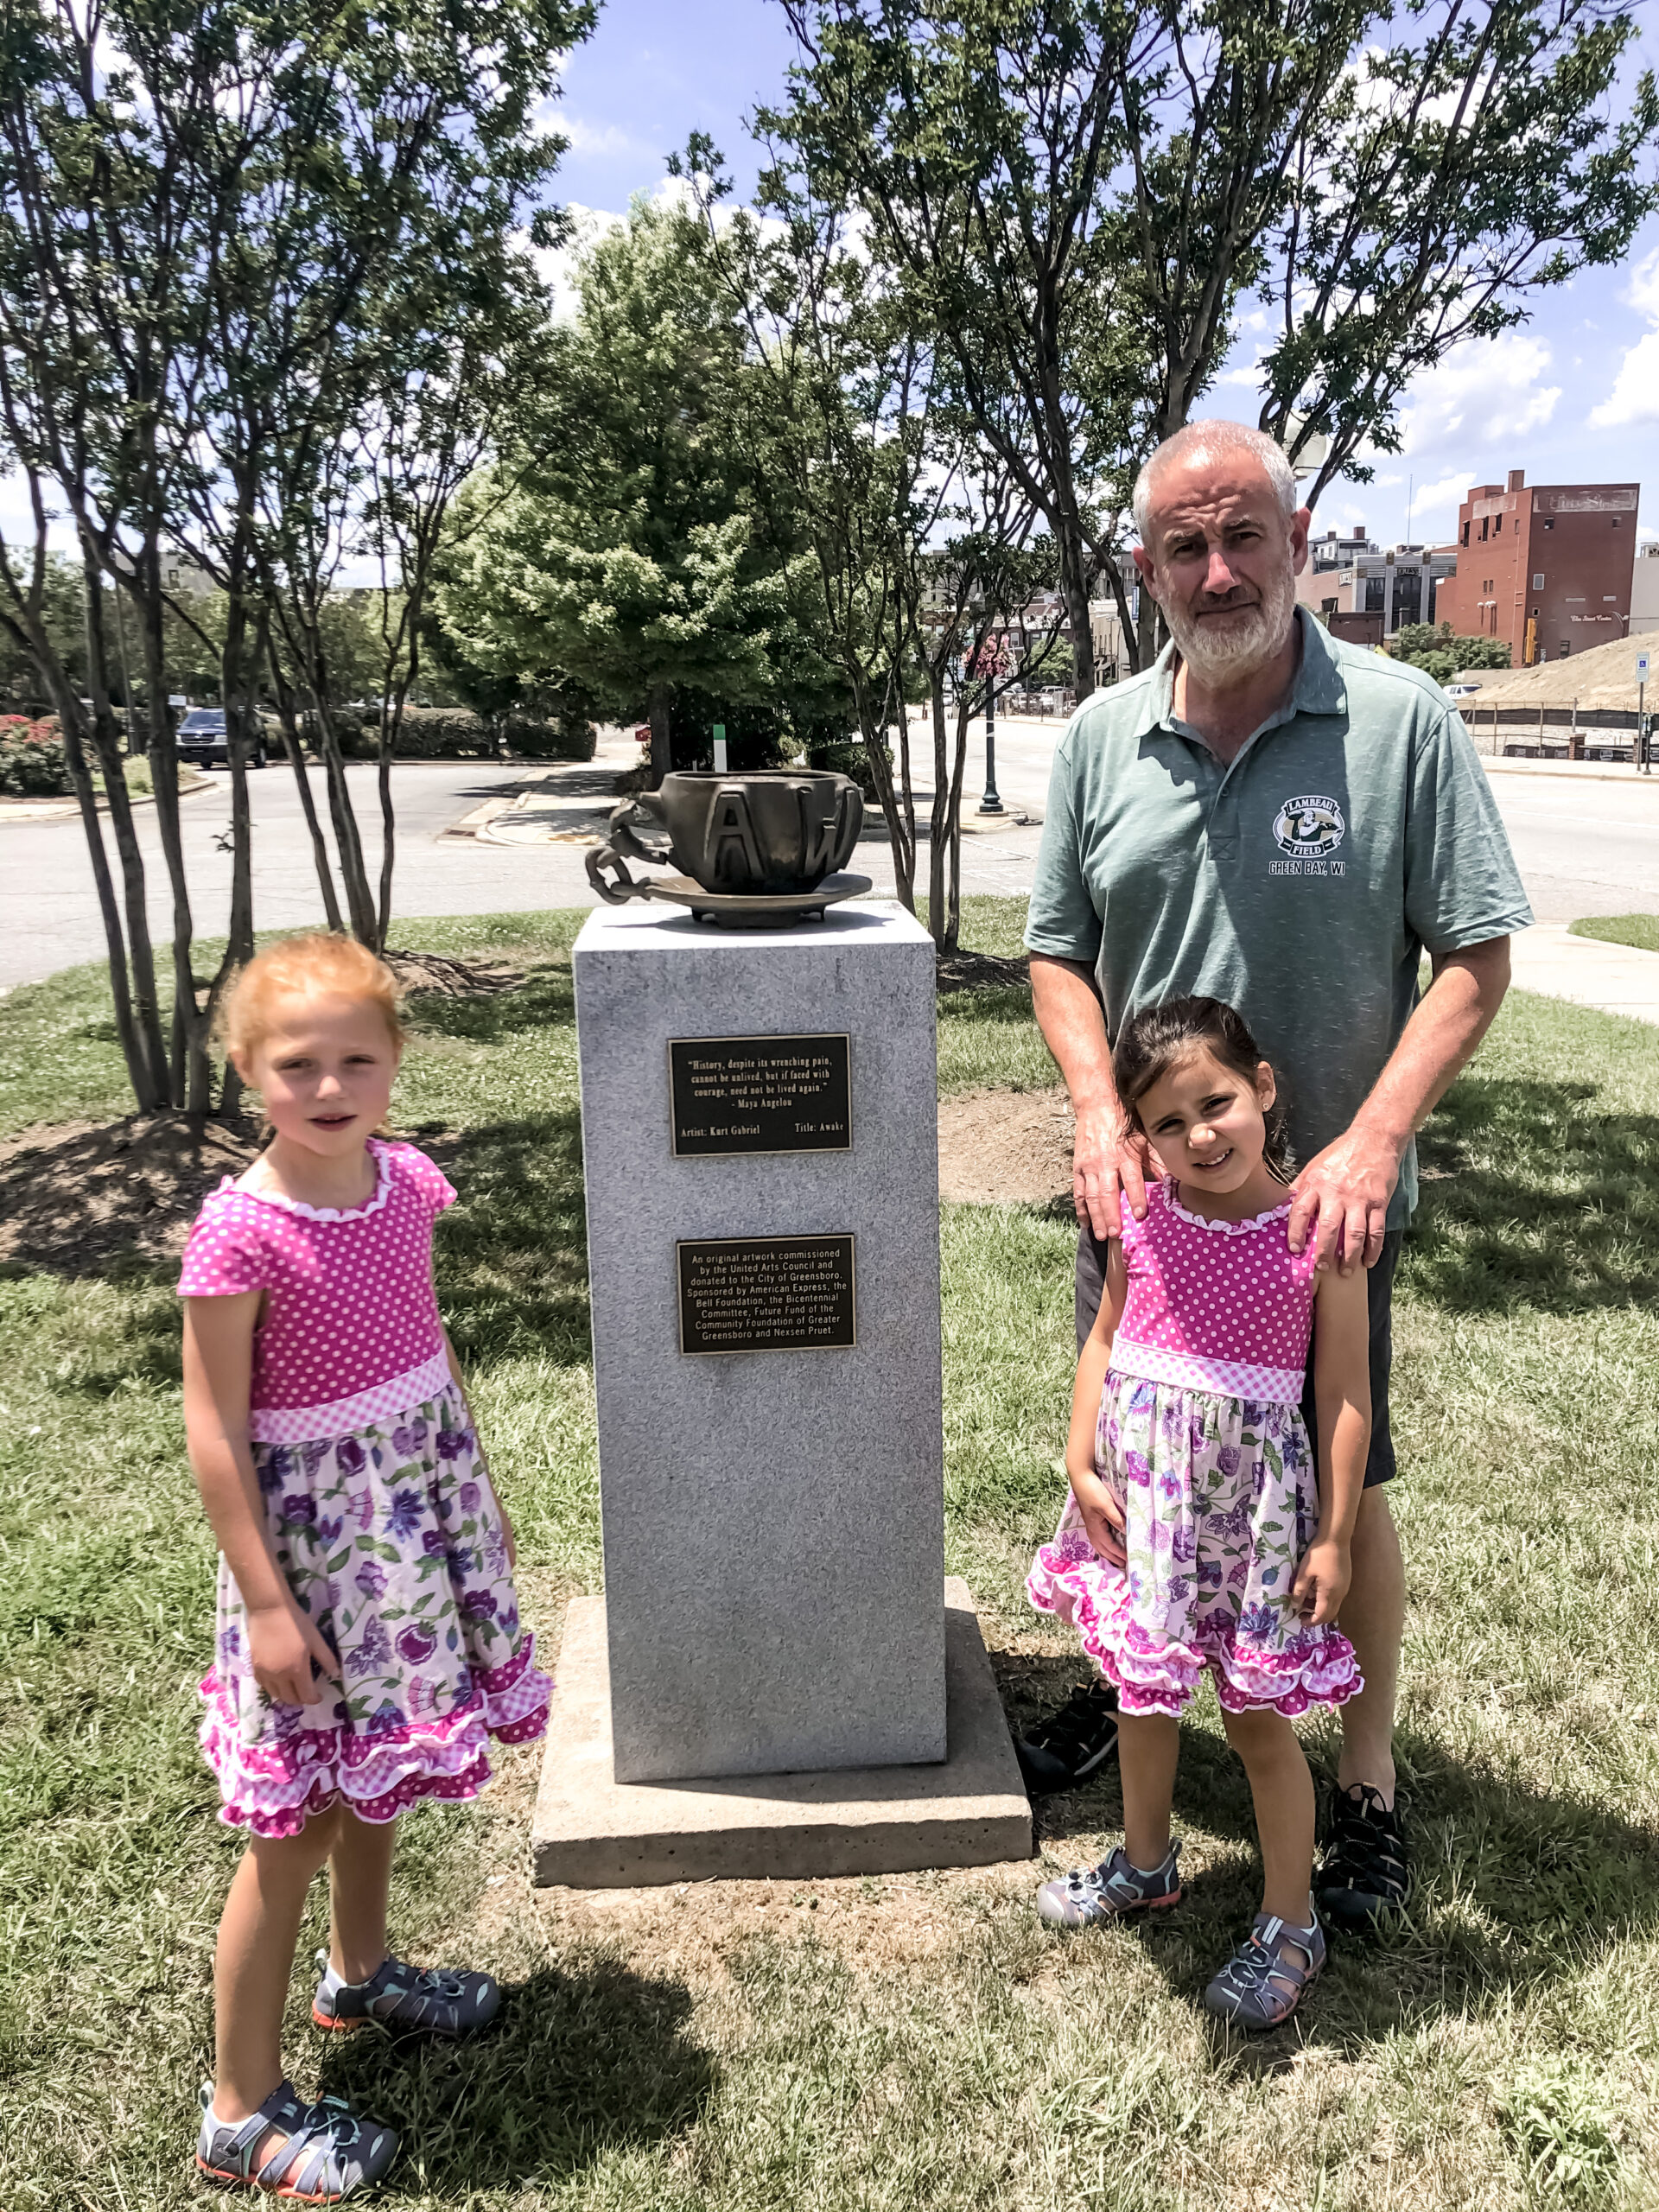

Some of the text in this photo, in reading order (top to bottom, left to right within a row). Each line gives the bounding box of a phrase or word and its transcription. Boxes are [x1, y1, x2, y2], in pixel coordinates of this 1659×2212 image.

[1288, 798, 1333, 811] LAMBEAU
[1293, 845, 1321, 855] FIELD
[1269, 861, 1345, 876] GREEN BAY, WI
[728, 1059, 754, 1069] despite
[758, 1058, 767, 1067] its
[771, 1057, 810, 1067] wrenching
[813, 1057, 832, 1067] pain,
[732, 1073, 763, 1082] unlived,
[813, 1070, 830, 1078] with
[695, 1089, 728, 1097] courage,
[778, 1084, 796, 1093] lived
[738, 1100, 757, 1109] Maya
[761, 1098, 791, 1109] Angelou
[681, 1125, 760, 1137] Artist: Kurt Gabriel
[795, 1122, 843, 1132] Title: Awake
[706, 1255, 739, 1264] original
[742, 1252, 775, 1262] artwork
[779, 1249, 840, 1260] commissioned
[700, 1267, 709, 1276] by
[714, 1265, 727, 1274] the
[731, 1264, 758, 1273] United
[761, 1262, 779, 1271] Arts
[782, 1262, 814, 1270] Council
[690, 1277, 725, 1286] donated
[758, 1274, 774, 1283] City
[790, 1272, 842, 1281] Greensboro.
[687, 1287, 733, 1297] Sponsored
[737, 1287, 746, 1295] by
[750, 1285, 790, 1294] American
[793, 1283, 830, 1293] Express,
[696, 1299, 713, 1307] Bell
[716, 1297, 766, 1306] Foundation,
[786, 1294, 838, 1303] Bicentennial
[702, 1309, 751, 1318] Committee,
[785, 1306, 805, 1314] Fund
[696, 1319, 742, 1330] Community
[747, 1318, 792, 1326] Foundation
[809, 1315, 840, 1324] Greater
[702, 1331, 752, 1340] Greensboro
[809, 1326, 834, 1335] Pruet.
